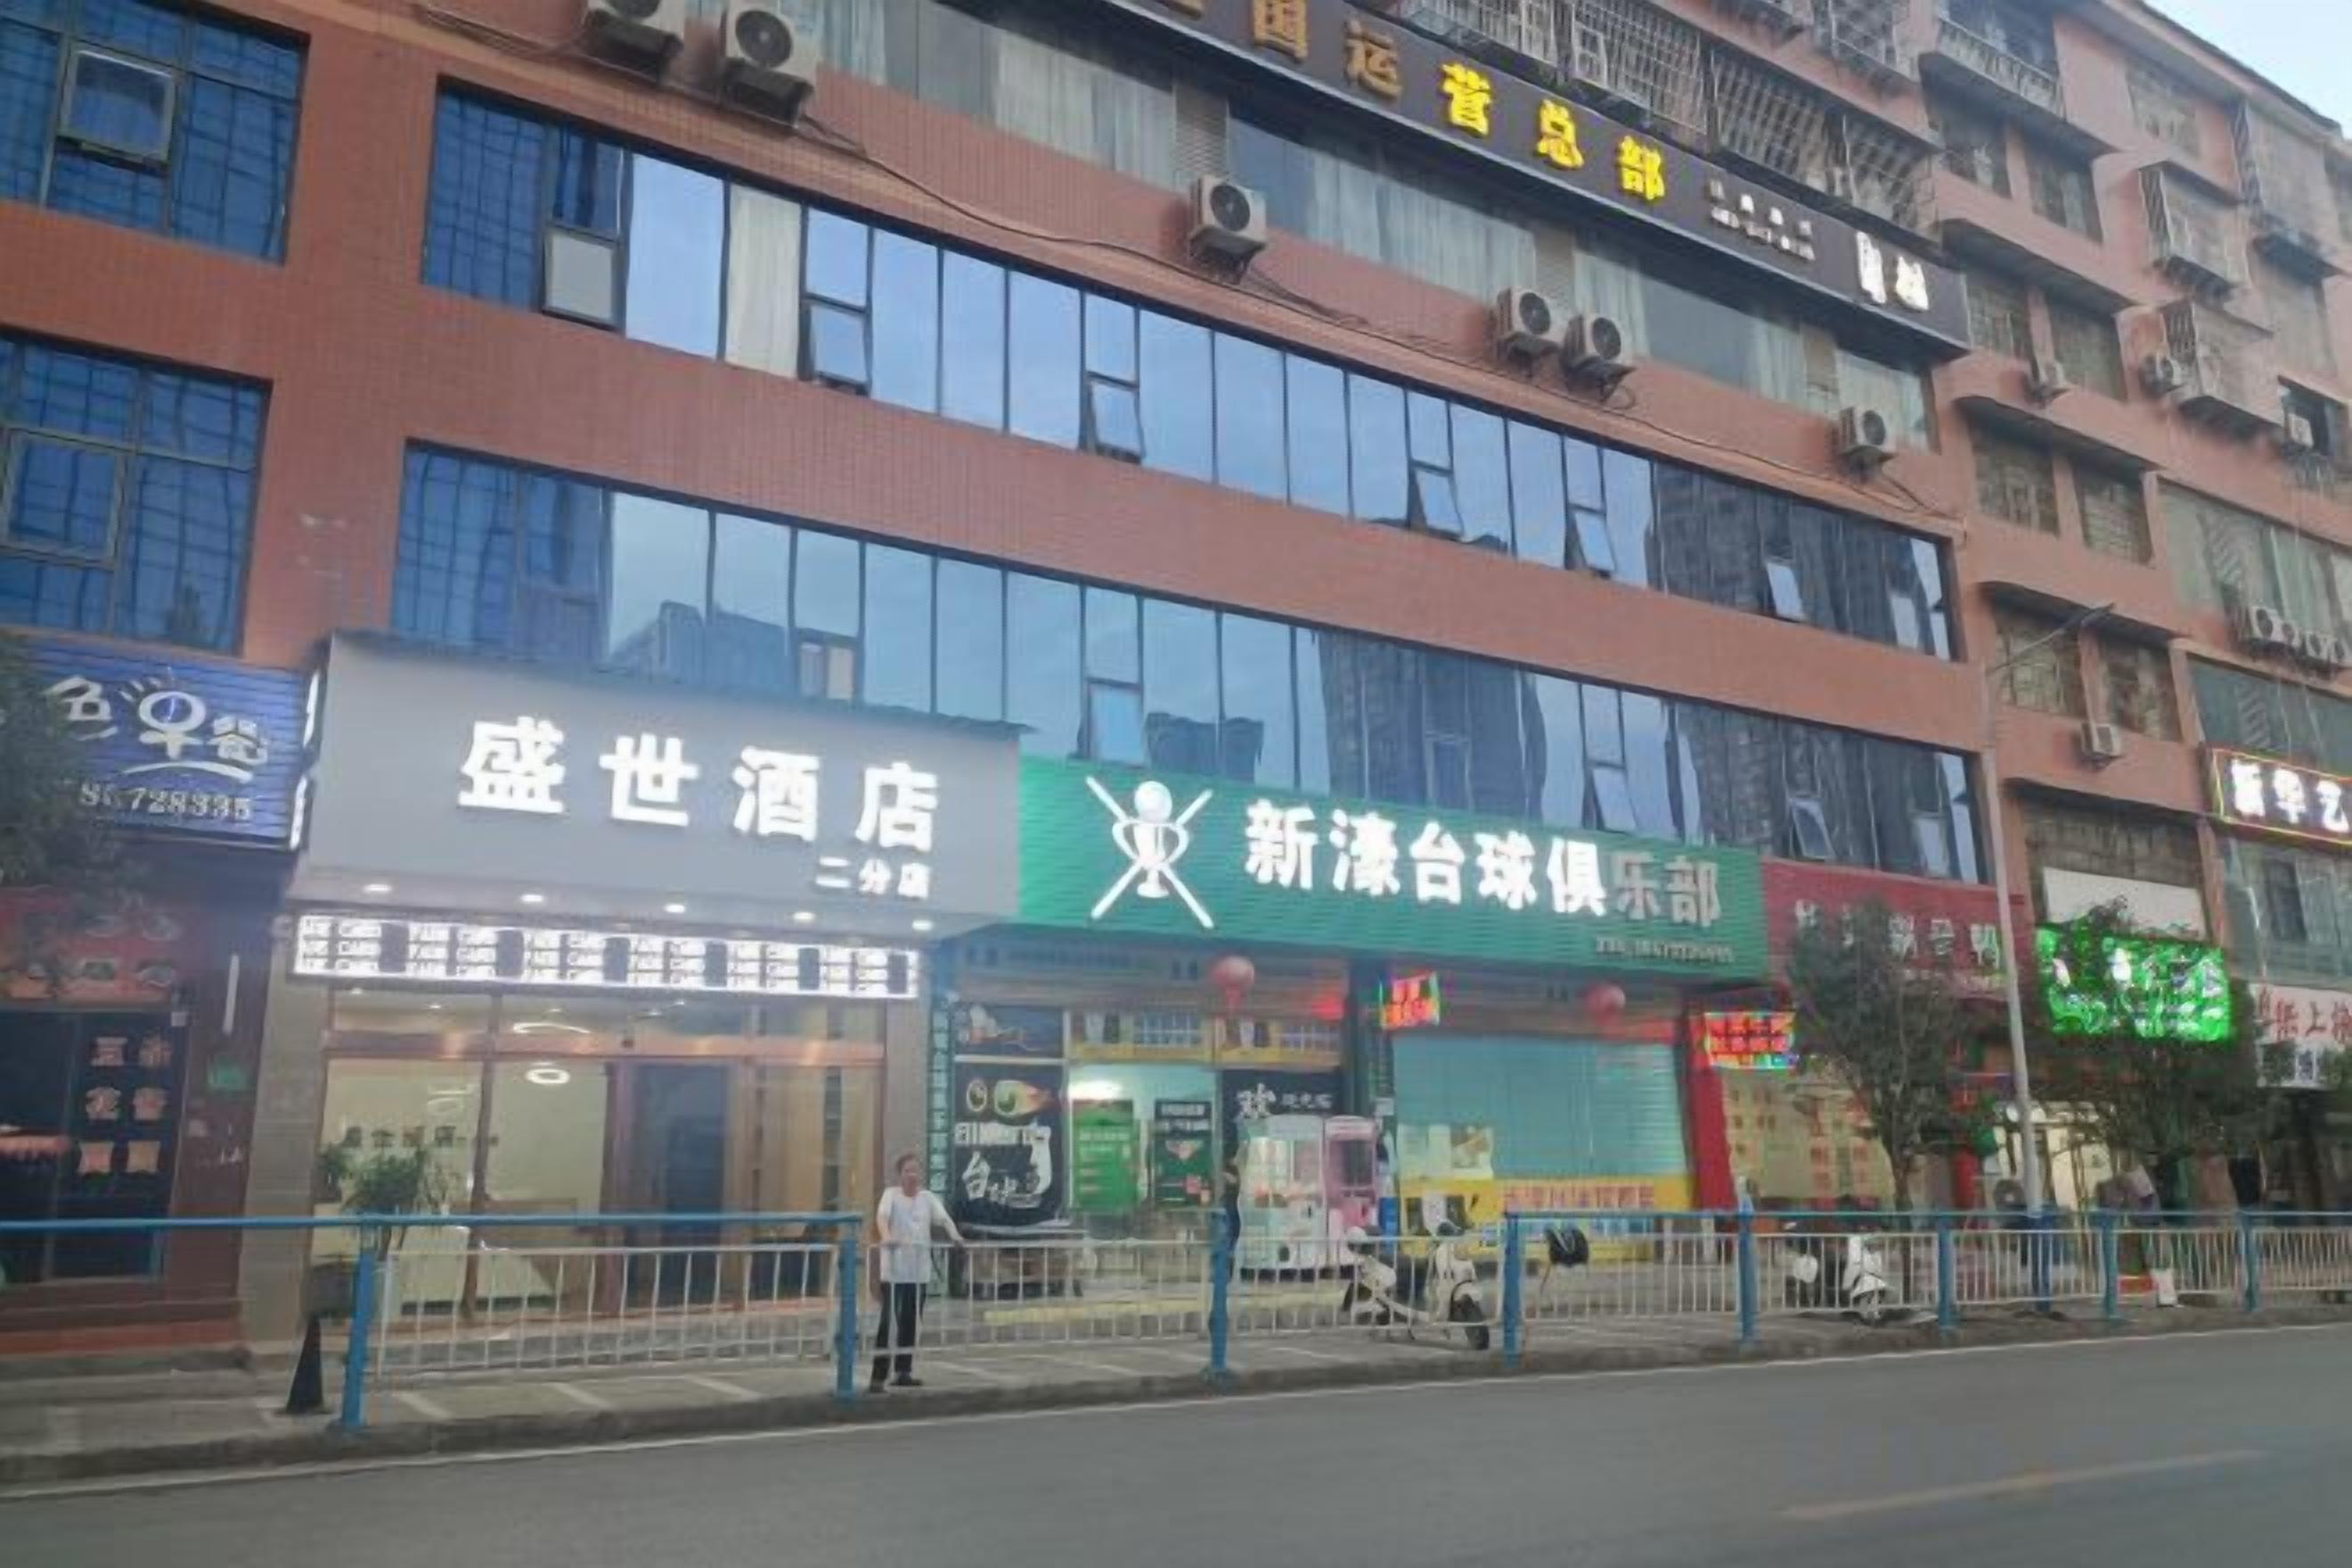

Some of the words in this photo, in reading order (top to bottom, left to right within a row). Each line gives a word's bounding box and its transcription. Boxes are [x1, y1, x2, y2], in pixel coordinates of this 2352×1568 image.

[1149, 0, 1664, 202] 国运营总部
[458, 715, 940, 852] 盛世酒店
[815, 856, 931, 899] 二分店
[1245, 797, 1721, 927] 新濠台球俱乐部
